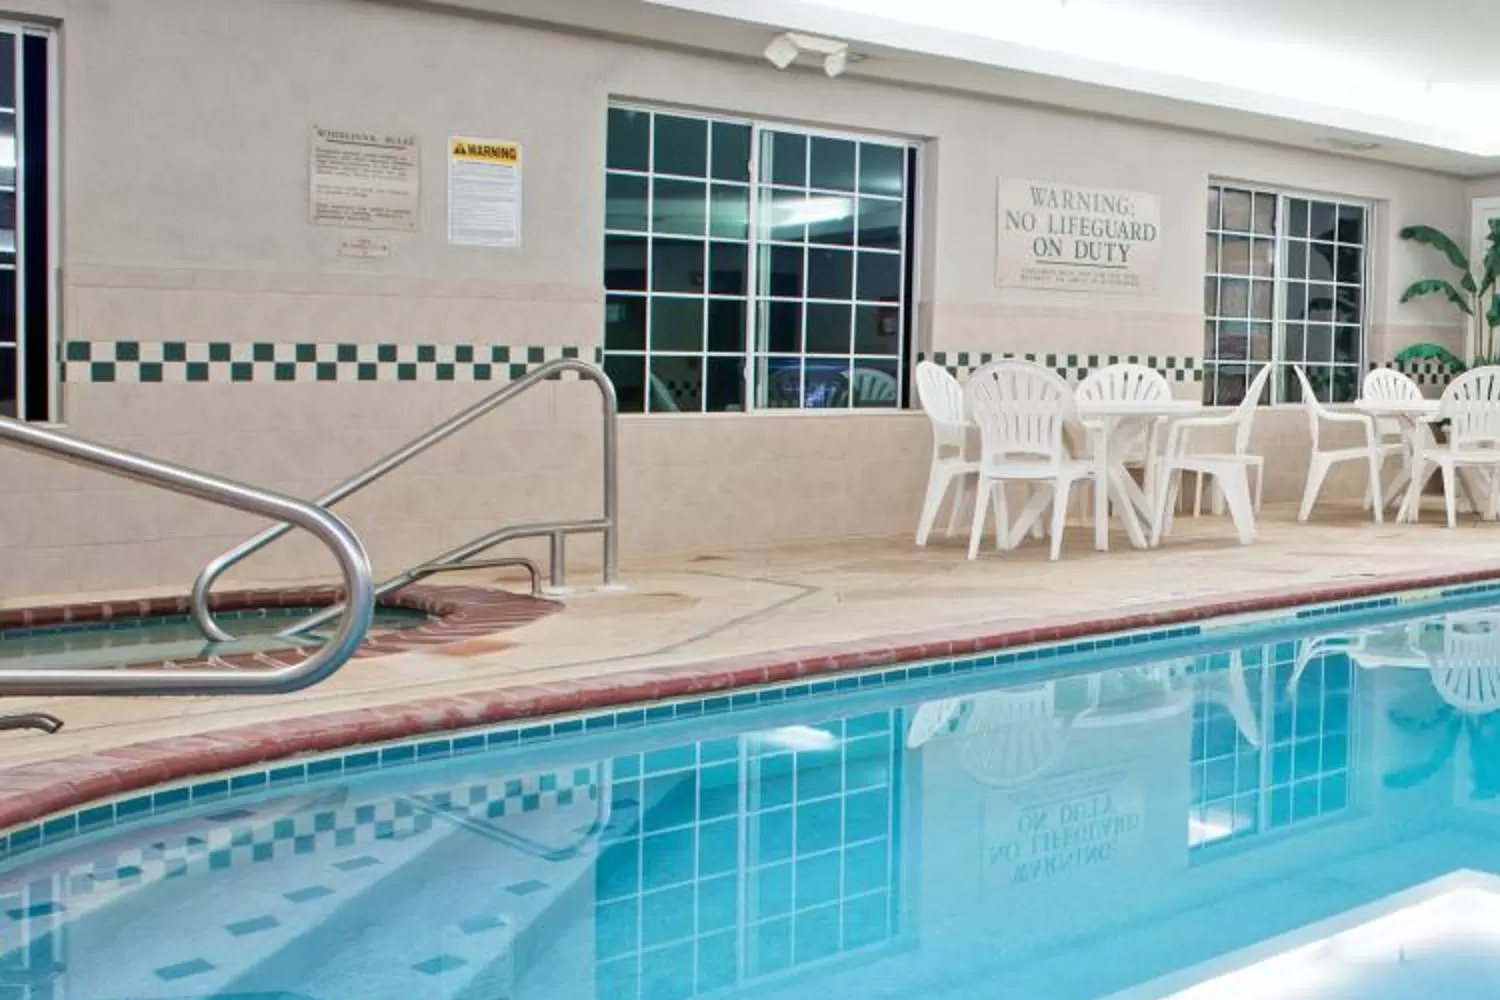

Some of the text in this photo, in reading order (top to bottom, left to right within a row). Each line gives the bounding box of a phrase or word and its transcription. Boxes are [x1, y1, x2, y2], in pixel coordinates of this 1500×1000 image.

[467, 143, 517, 161] WARNING
[1029, 185, 1136, 217] WARNING:
[1006, 208, 1157, 242] NO LIFEGUARD
[1033, 236, 1131, 263] ON DUTY
